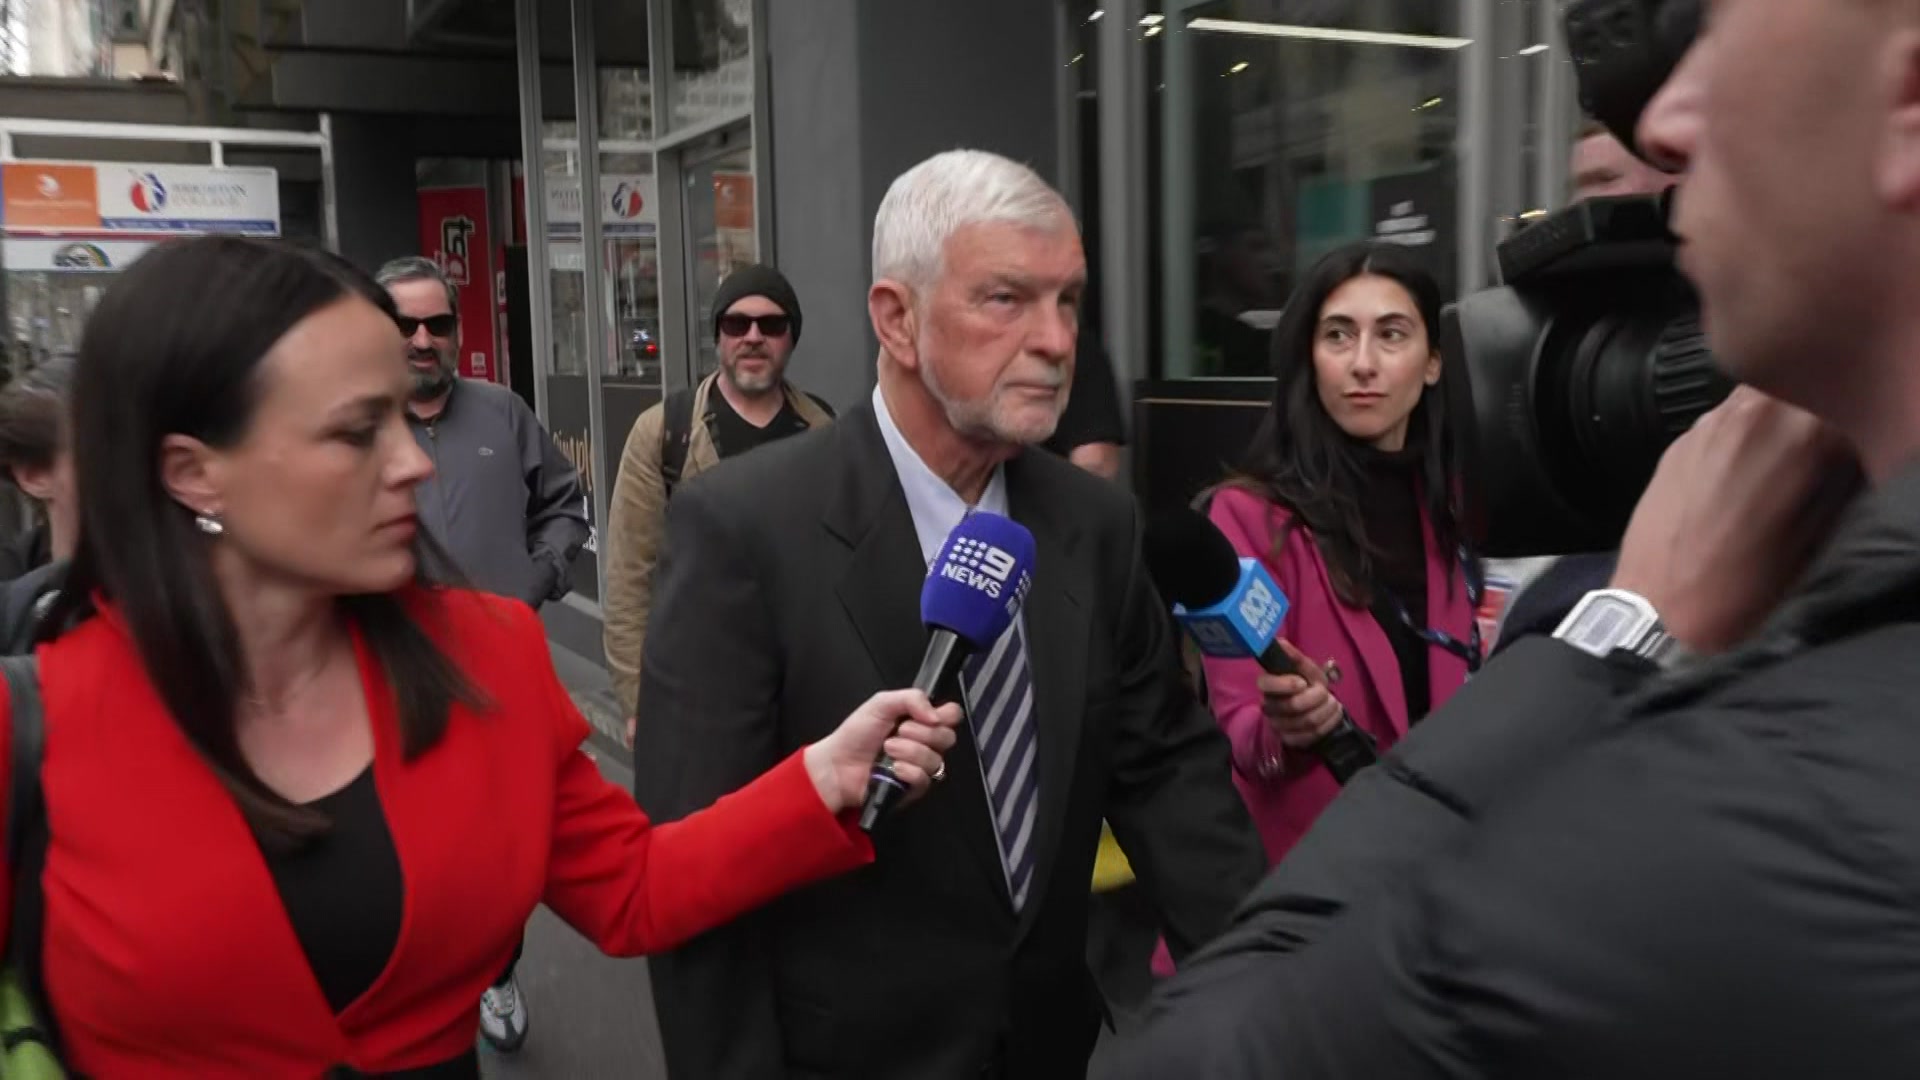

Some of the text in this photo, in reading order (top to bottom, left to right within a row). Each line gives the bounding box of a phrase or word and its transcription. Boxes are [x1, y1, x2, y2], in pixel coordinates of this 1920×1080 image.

[940, 562, 1003, 599] NEWS
[978, 545, 1016, 582] 9
[1257, 600, 1283, 640] NEWS
